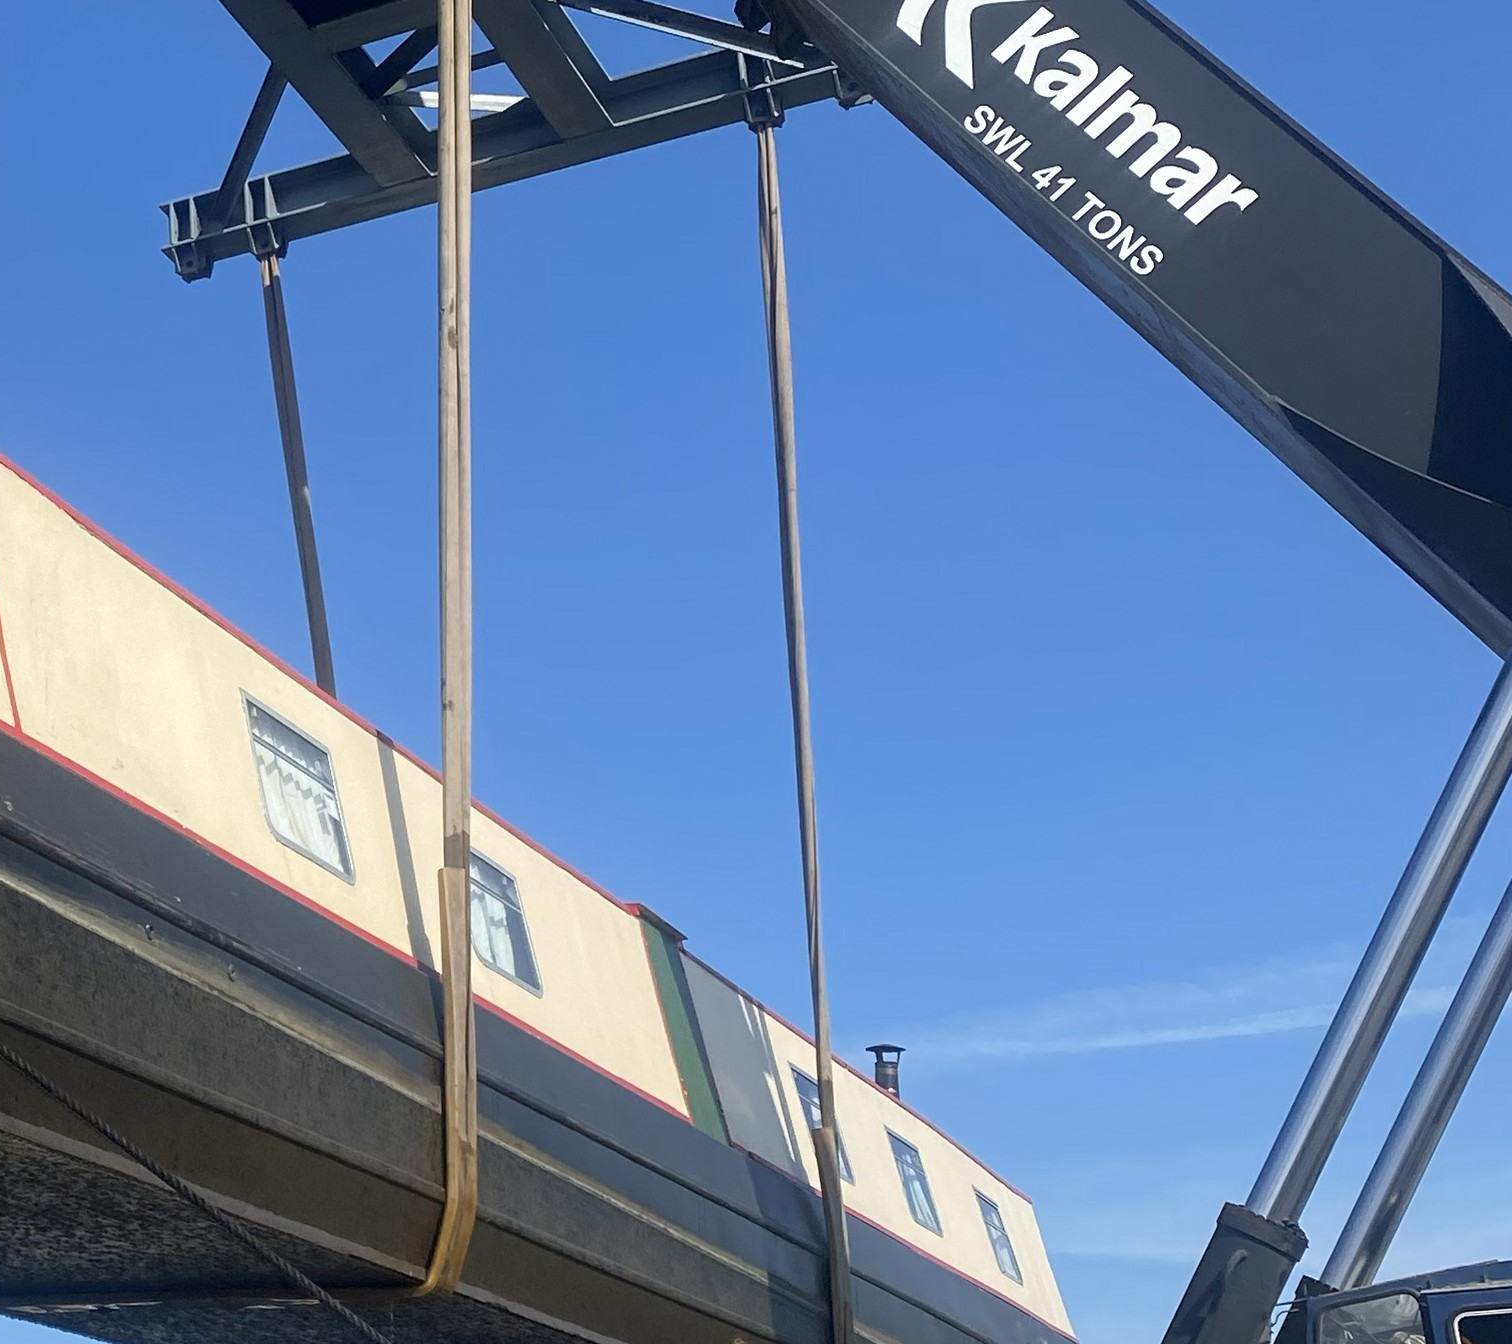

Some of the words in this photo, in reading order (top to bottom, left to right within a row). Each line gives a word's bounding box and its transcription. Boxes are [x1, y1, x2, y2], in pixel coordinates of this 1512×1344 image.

[963, 105, 1032, 173] SWL
[1031, 165, 1076, 202] 41
[1071, 191, 1164, 276] TONS
[990, 6, 1259, 226] Kalmar
